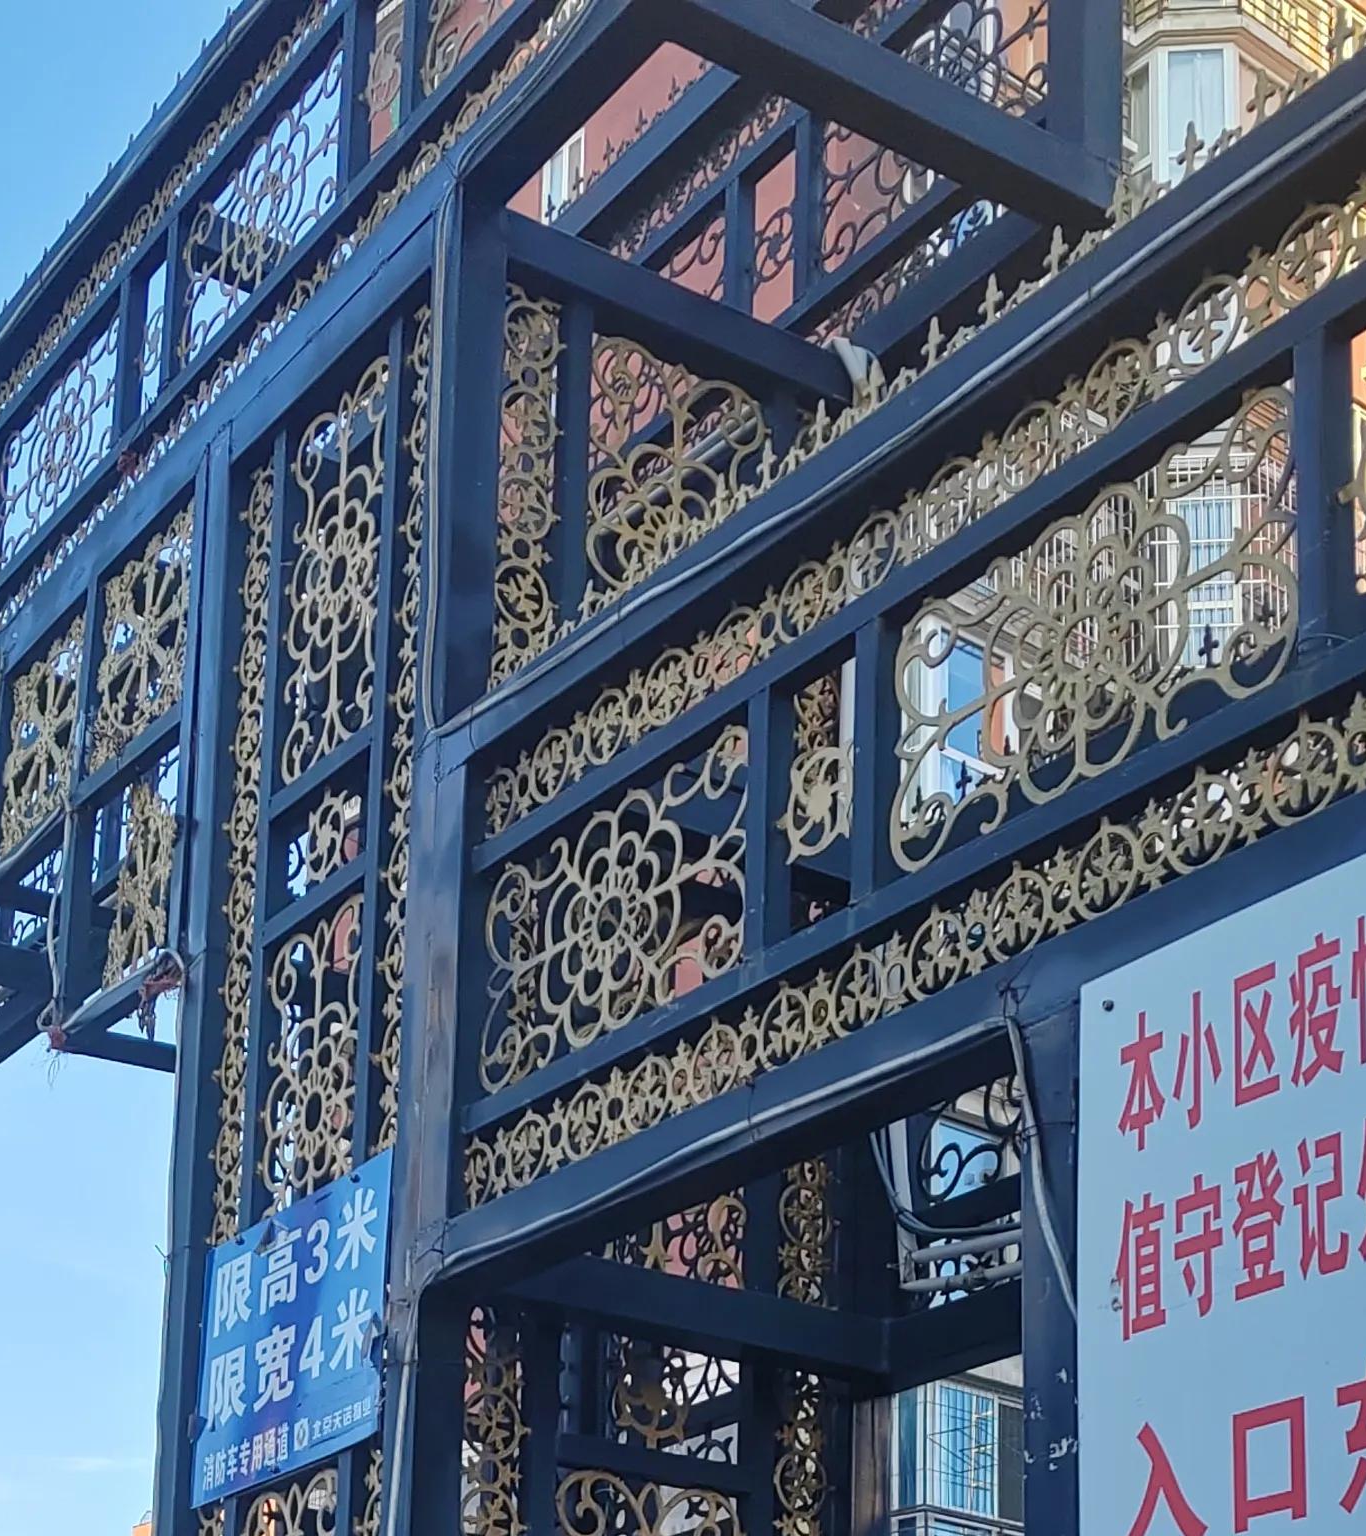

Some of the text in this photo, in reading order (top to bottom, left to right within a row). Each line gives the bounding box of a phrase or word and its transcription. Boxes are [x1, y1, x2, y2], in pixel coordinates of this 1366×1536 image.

[212, 1187, 379, 1338] 限高3米
[207, 1287, 378, 1432] 限宽4米
[202, 1422, 290, 1491] 消防车专用通道
